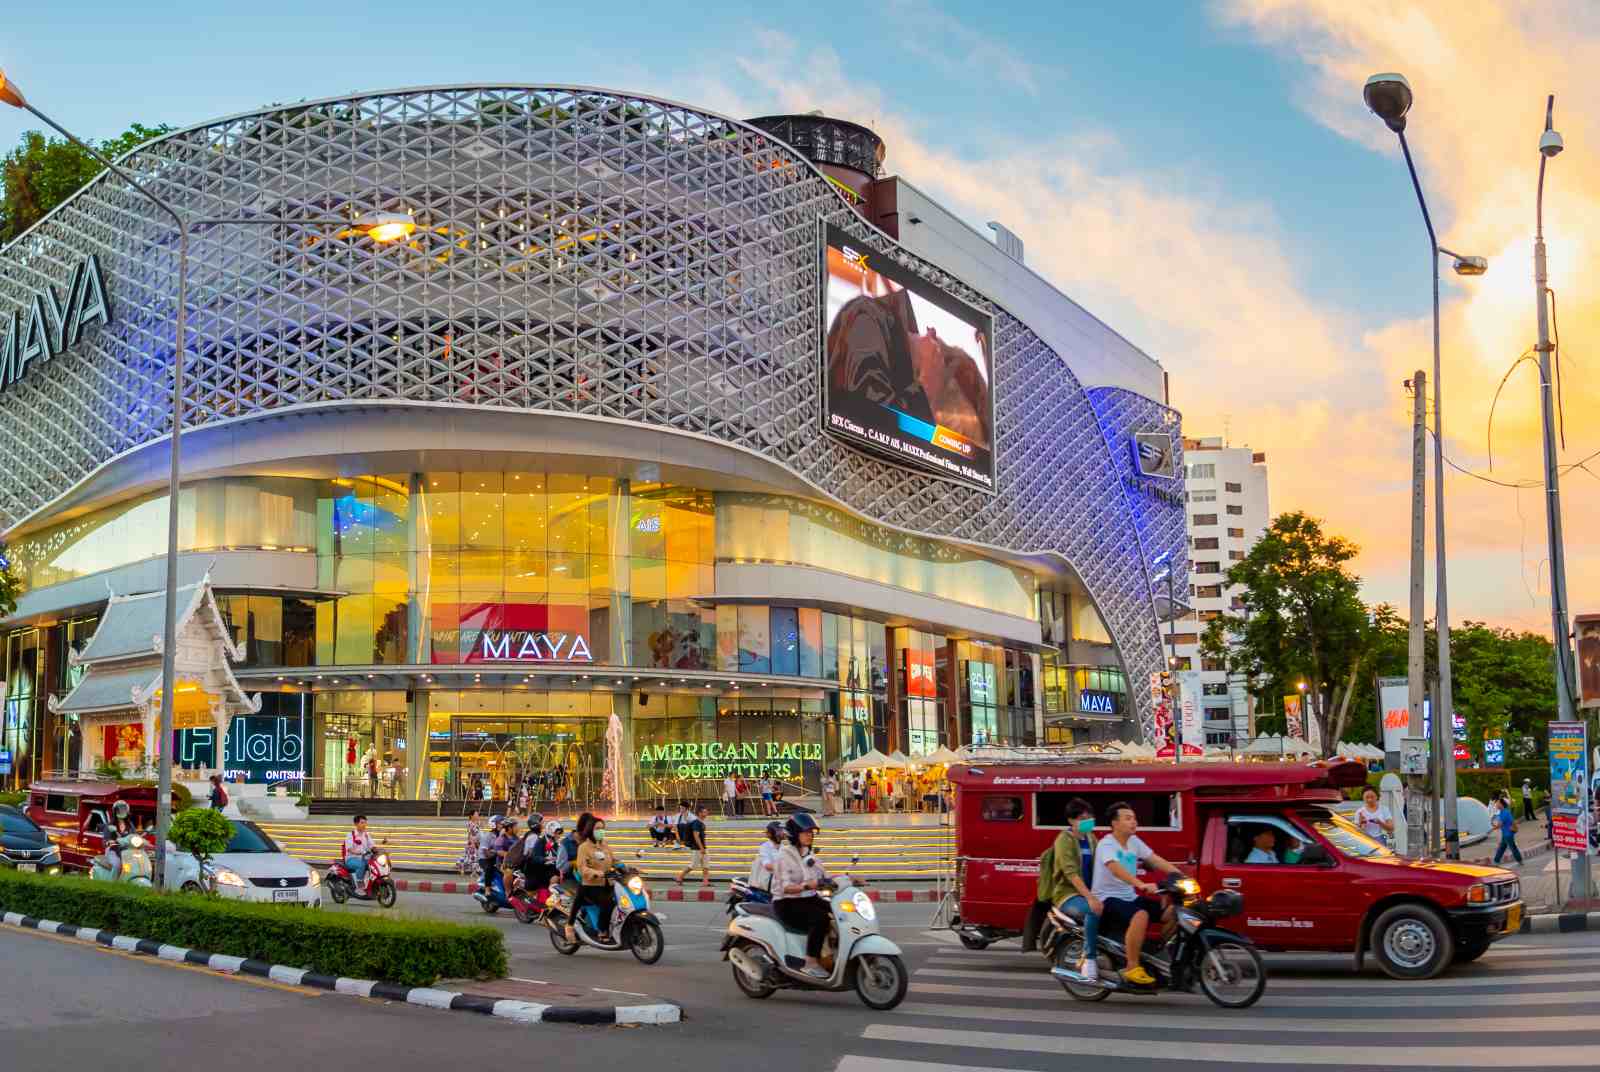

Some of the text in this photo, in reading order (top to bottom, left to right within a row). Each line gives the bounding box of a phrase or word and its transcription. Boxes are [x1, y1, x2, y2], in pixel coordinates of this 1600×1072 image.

[482, 634, 593, 660] MAYA
[1081, 694, 1113, 714] MAYA
[639, 742, 822, 761] AMERICAN EAGLE
[677, 763, 792, 779] OUTFITTERS
